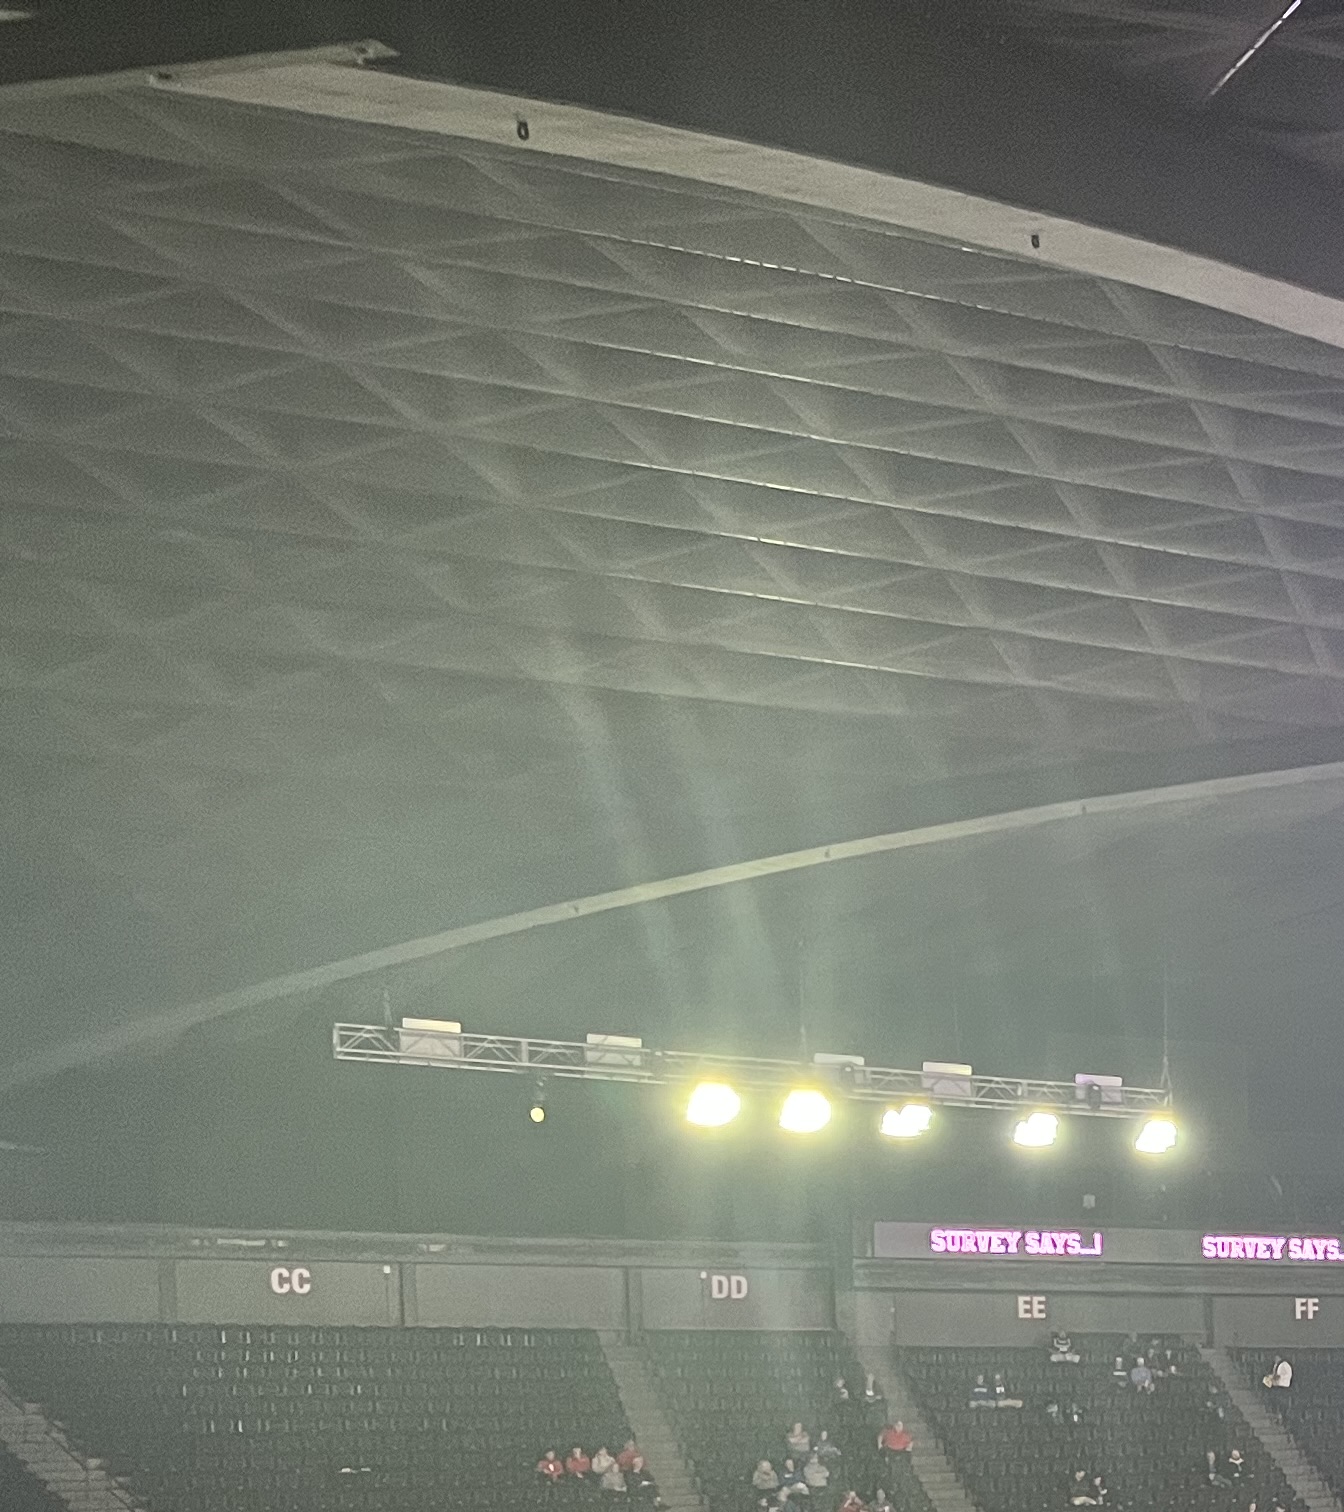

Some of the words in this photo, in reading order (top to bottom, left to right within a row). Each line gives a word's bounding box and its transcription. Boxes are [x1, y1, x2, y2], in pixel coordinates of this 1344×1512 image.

[930, 1229, 1021, 1254] SURVEY
[1201, 1234, 1286, 1260] SURVEY
[270, 1267, 311, 1294] CC
[711, 1274, 748, 1299] DD
[1017, 1296, 1046, 1319] EE
[1295, 1298, 1319, 1320] FF
